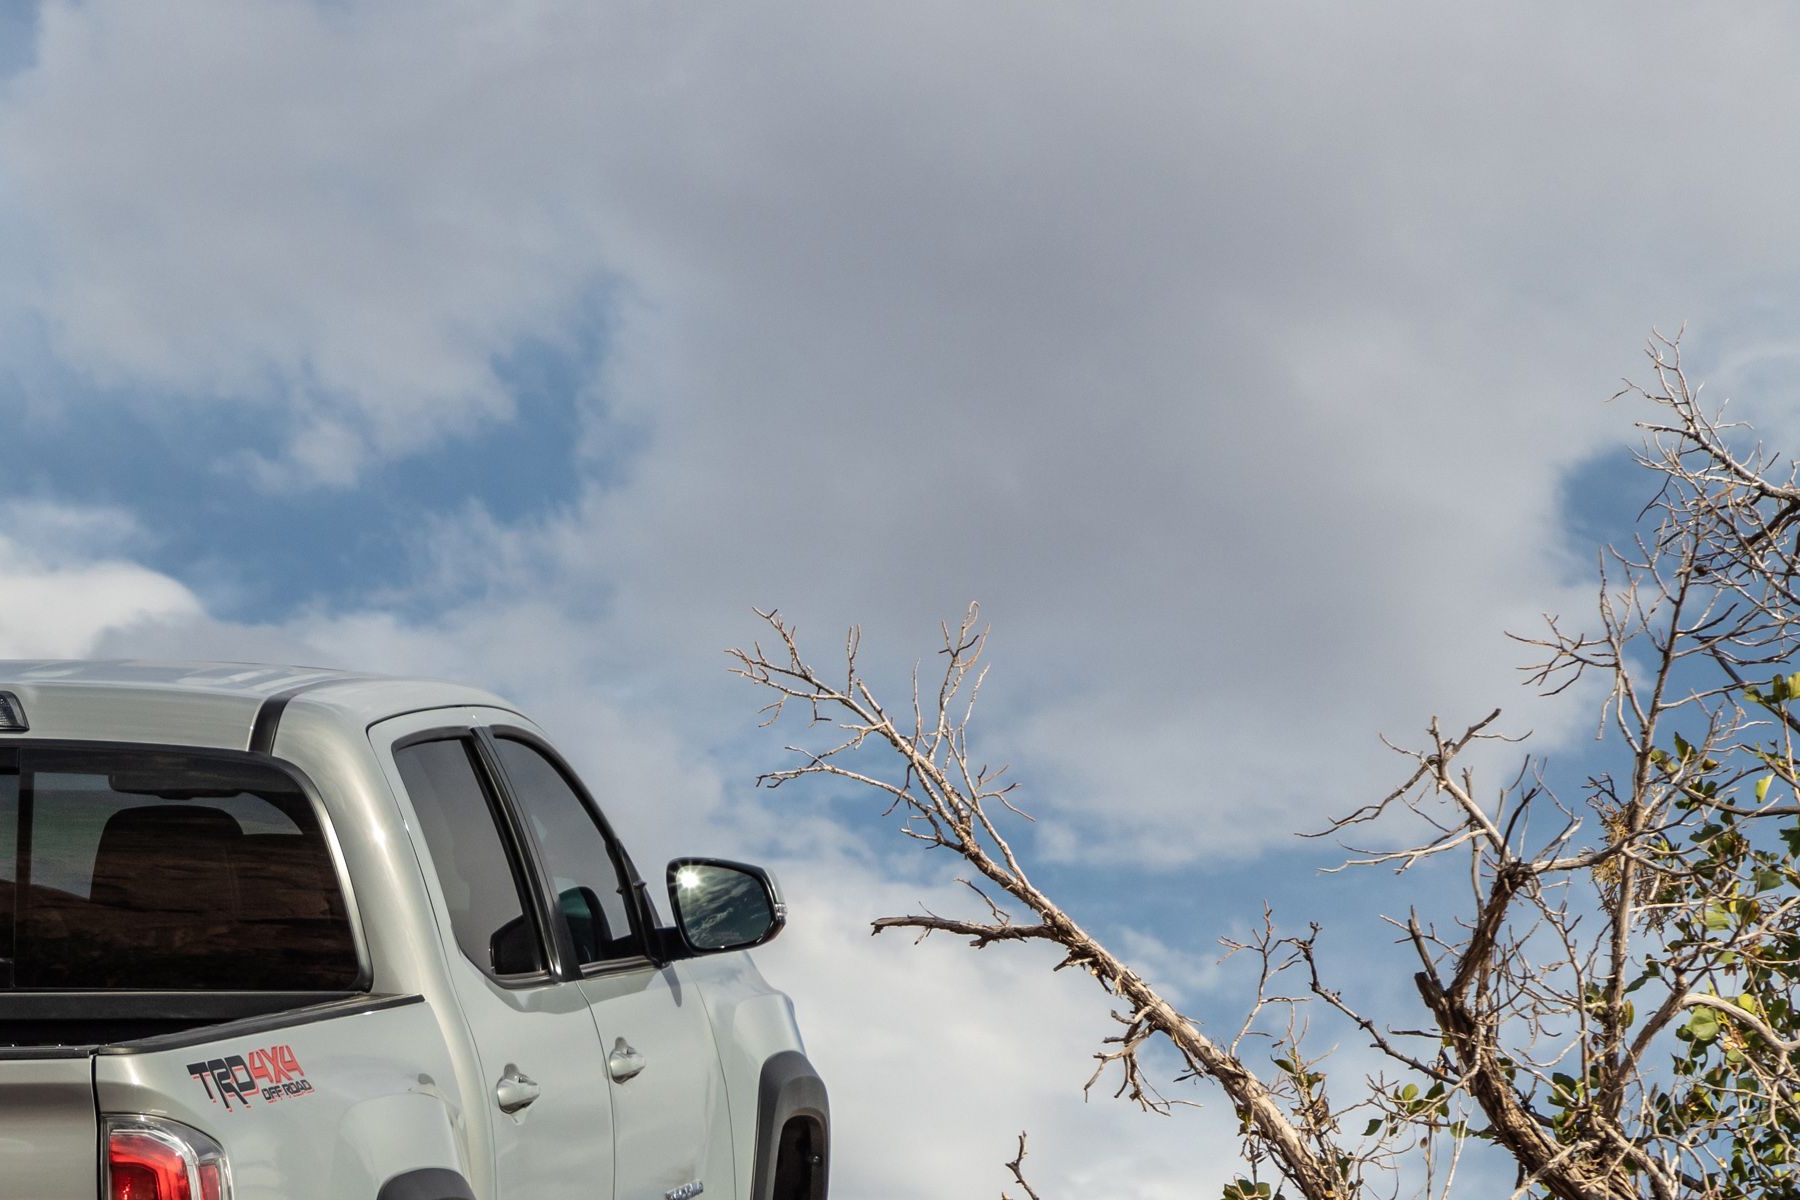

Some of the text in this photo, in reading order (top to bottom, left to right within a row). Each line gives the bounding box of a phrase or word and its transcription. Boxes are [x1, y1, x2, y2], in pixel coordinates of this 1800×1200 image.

[186, 1054, 258, 1111] TRD
[261, 1079, 314, 1101] OFF ROAD
